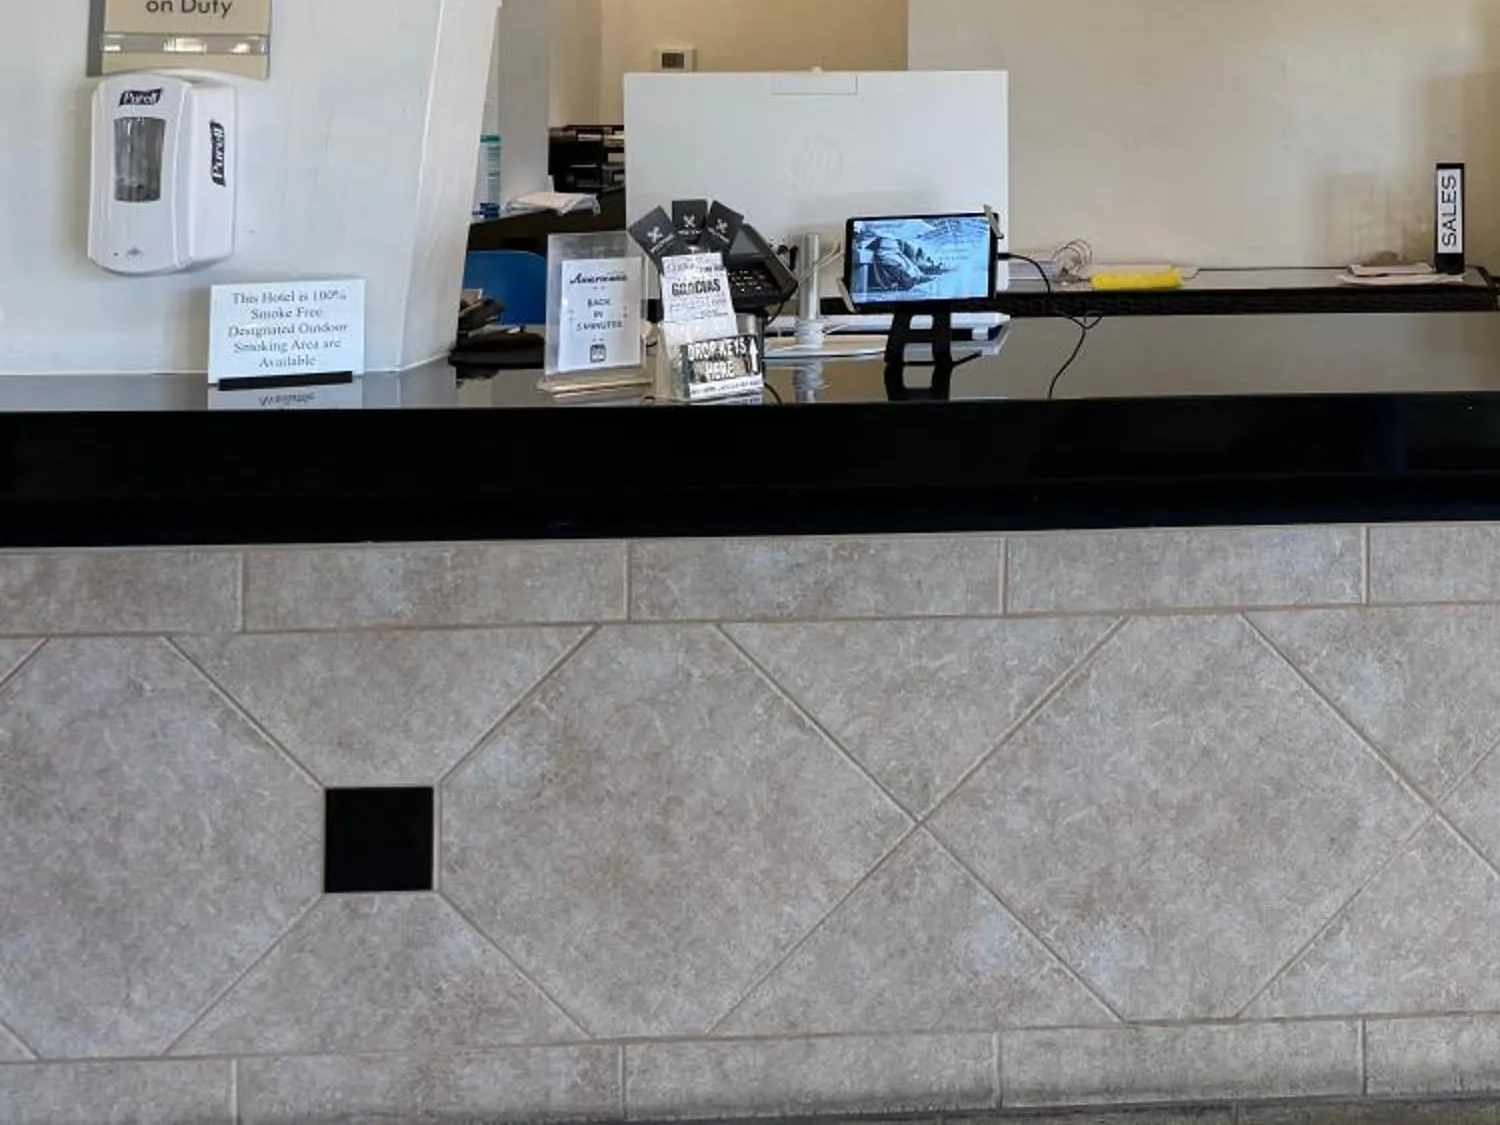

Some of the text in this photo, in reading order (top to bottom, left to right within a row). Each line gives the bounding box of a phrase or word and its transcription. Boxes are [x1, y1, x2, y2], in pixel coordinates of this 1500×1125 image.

[145, 0, 173, 12] on
[1441, 174, 1457, 247] SALES
[232, 289, 347, 304] This Hotel is 100%
[250, 307, 293, 320] Smoke
[228, 321, 348, 338] Designated Outdoor
[233, 339, 342, 354] Smoking Area are
[259, 355, 317, 369] Available
